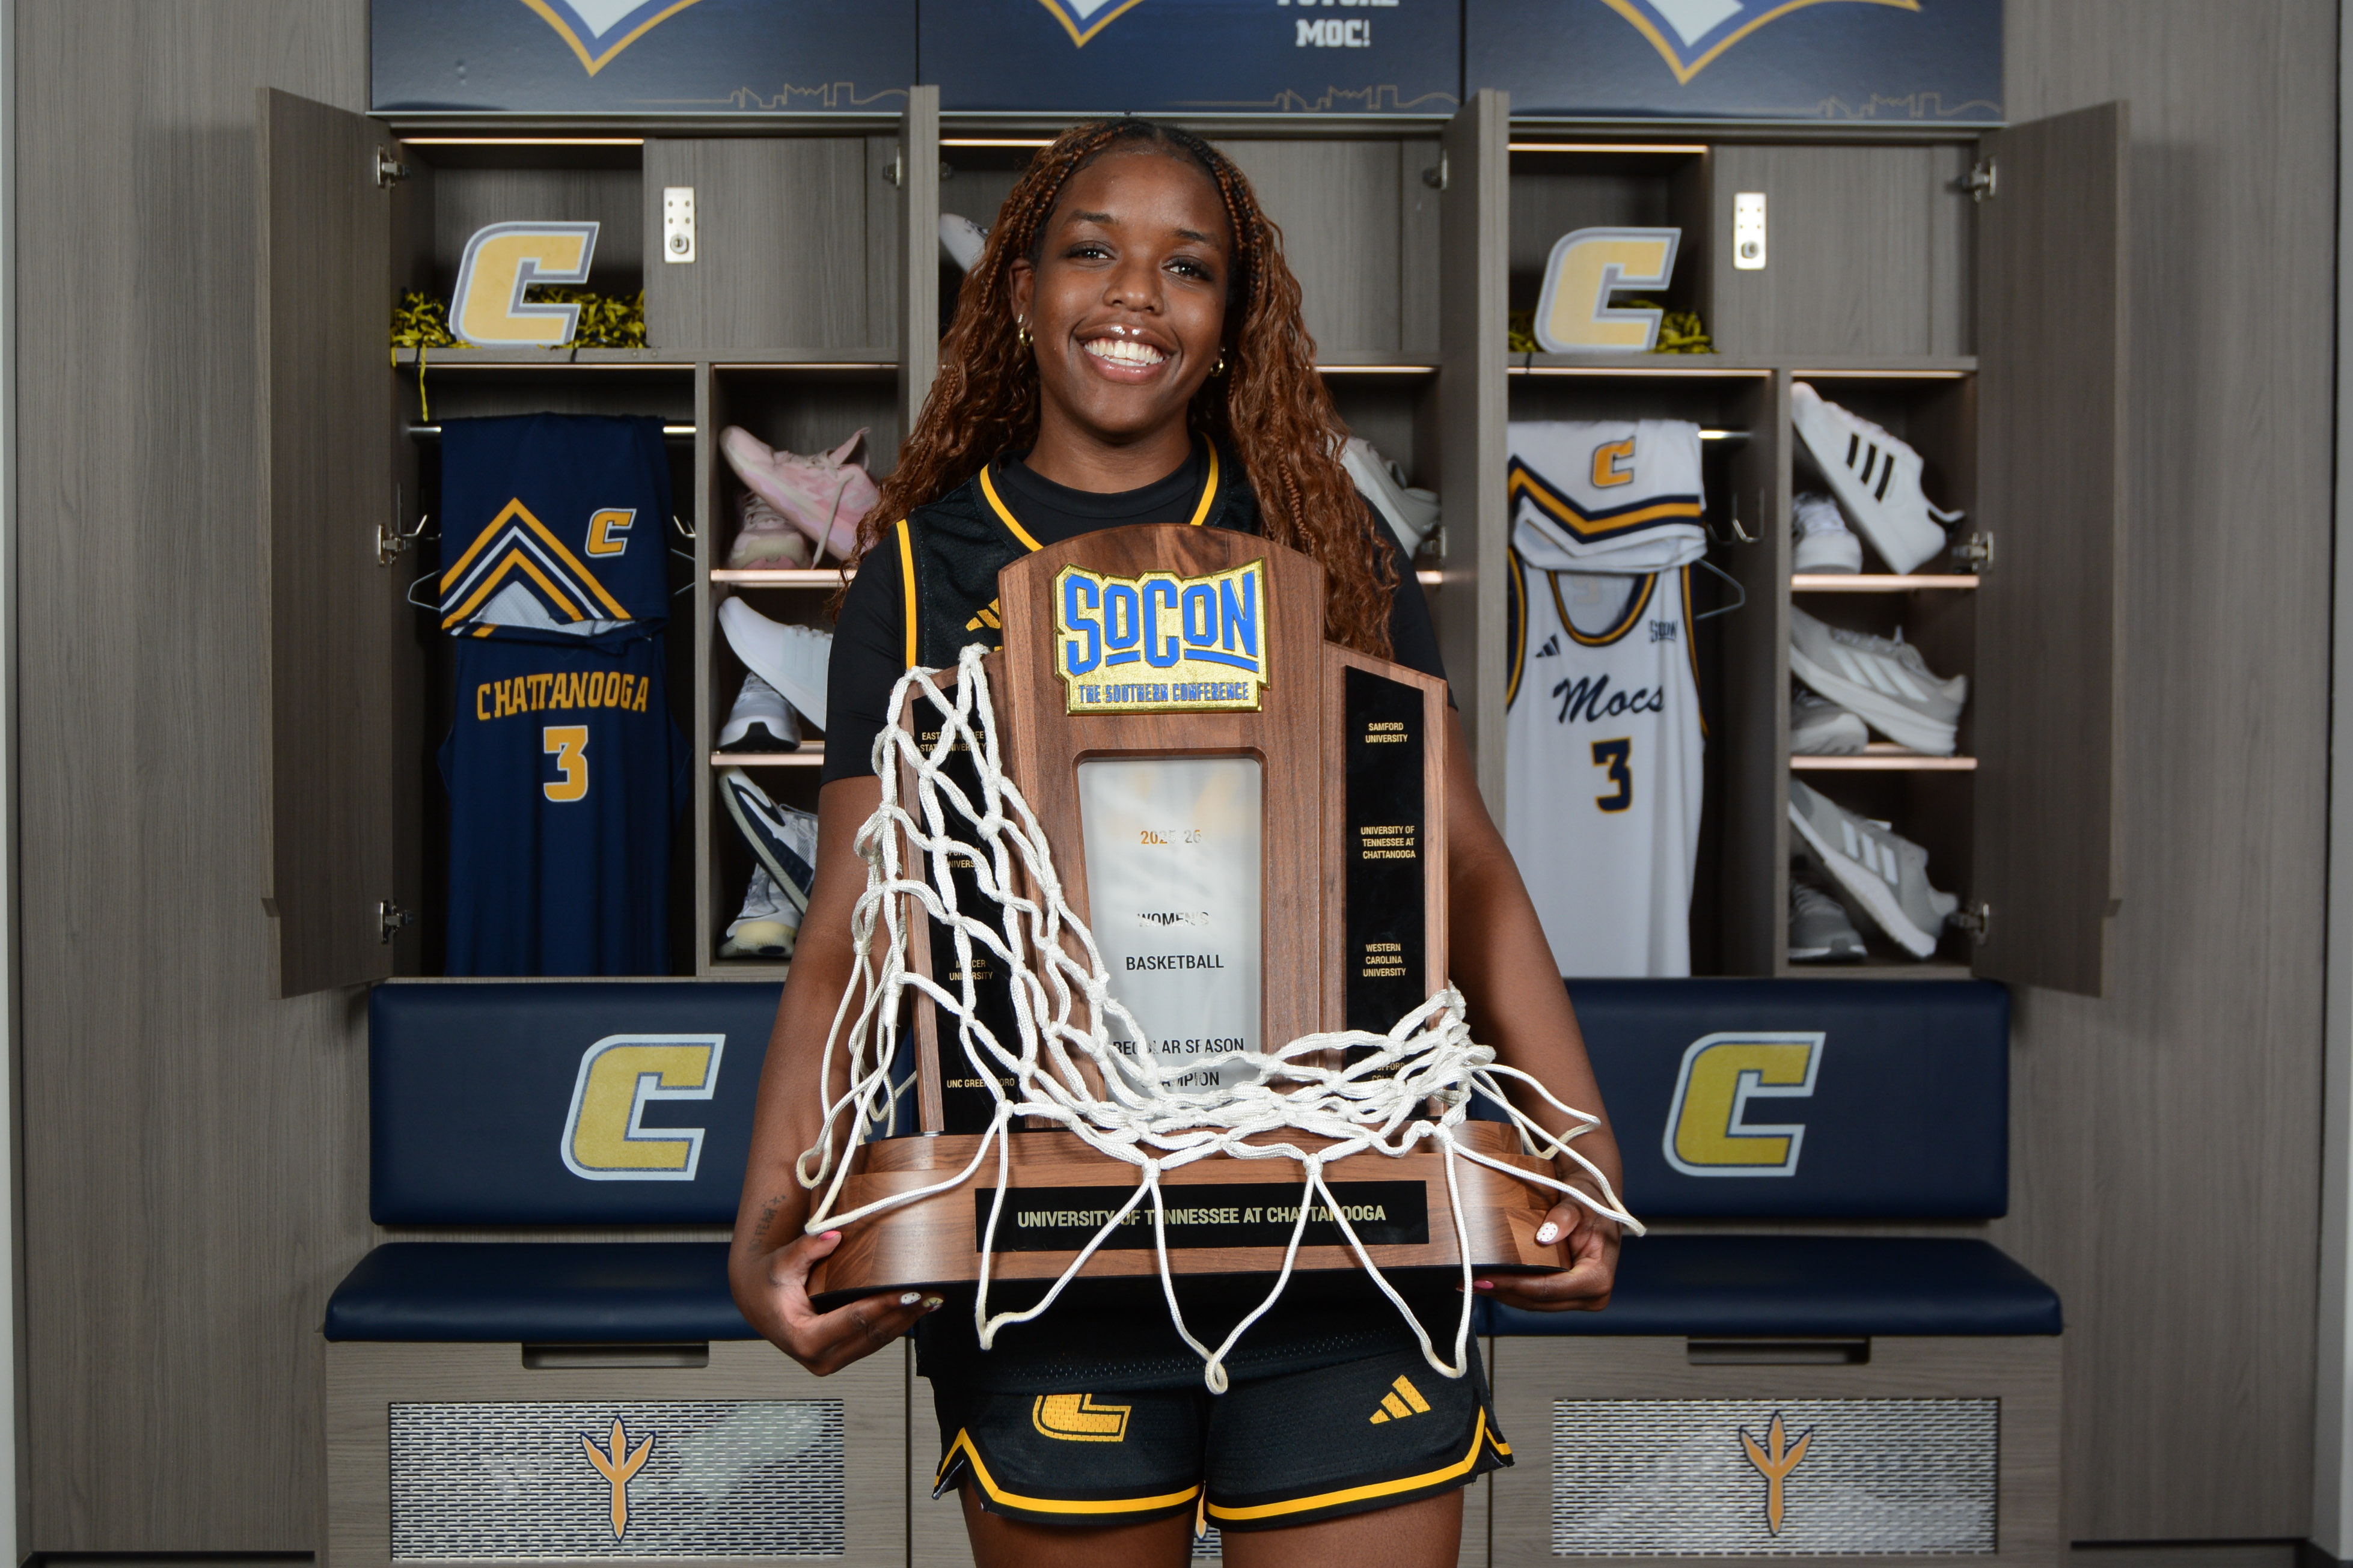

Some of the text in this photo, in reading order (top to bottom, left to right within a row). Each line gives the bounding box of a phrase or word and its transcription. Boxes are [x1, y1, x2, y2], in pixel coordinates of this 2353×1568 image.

[1296, 19, 1370, 47] MOC!
[448, 221, 600, 347] C
[1534, 227, 1681, 354] C
[1591, 437, 1635, 489] C
[585, 508, 637, 558] C
[477, 671, 649, 721] CHATTANOOGA
[1079, 682, 1249, 703] THE SOUTHERN CONFERENCE
[1552, 673, 1665, 725] Mocs
[1368, 722, 1404, 731] SAMFORD
[922, 732, 941, 740] EAST
[1365, 734, 1408, 743] UNIVERSITY
[920, 743, 987, 752] STAT NIVERY
[543, 725, 589, 802] 3
[1591, 736, 1632, 813] 3
[1140, 829, 1202, 844] 202526
[1360, 826, 1403, 835] UNIVERSITY
[1362, 838, 1415, 847] TENNESSEE AT
[1363, 850, 1416, 859] CHATTANOOGA
[1366, 944, 1401, 952] WESTERN
[956, 960, 986, 968] MCER
[1126, 954, 1224, 971] BASKETBALL
[1365, 956, 1403, 965] CAROLINA
[949, 972, 993, 981] UNIRSITY
[1363, 968, 1406, 977] UNIVERSITY
[1113, 1038, 1244, 1055] RELAR SEASON
[947, 1078, 1015, 1088] UNC GREEORO
[1158, 1072, 1220, 1087] AMPION
[560, 1034, 726, 1180] C
[1662, 1032, 1826, 1177] C
[1018, 1205, 1386, 1227] UNIVERSITY OF TNNESSEE AT CHATAOOGA
